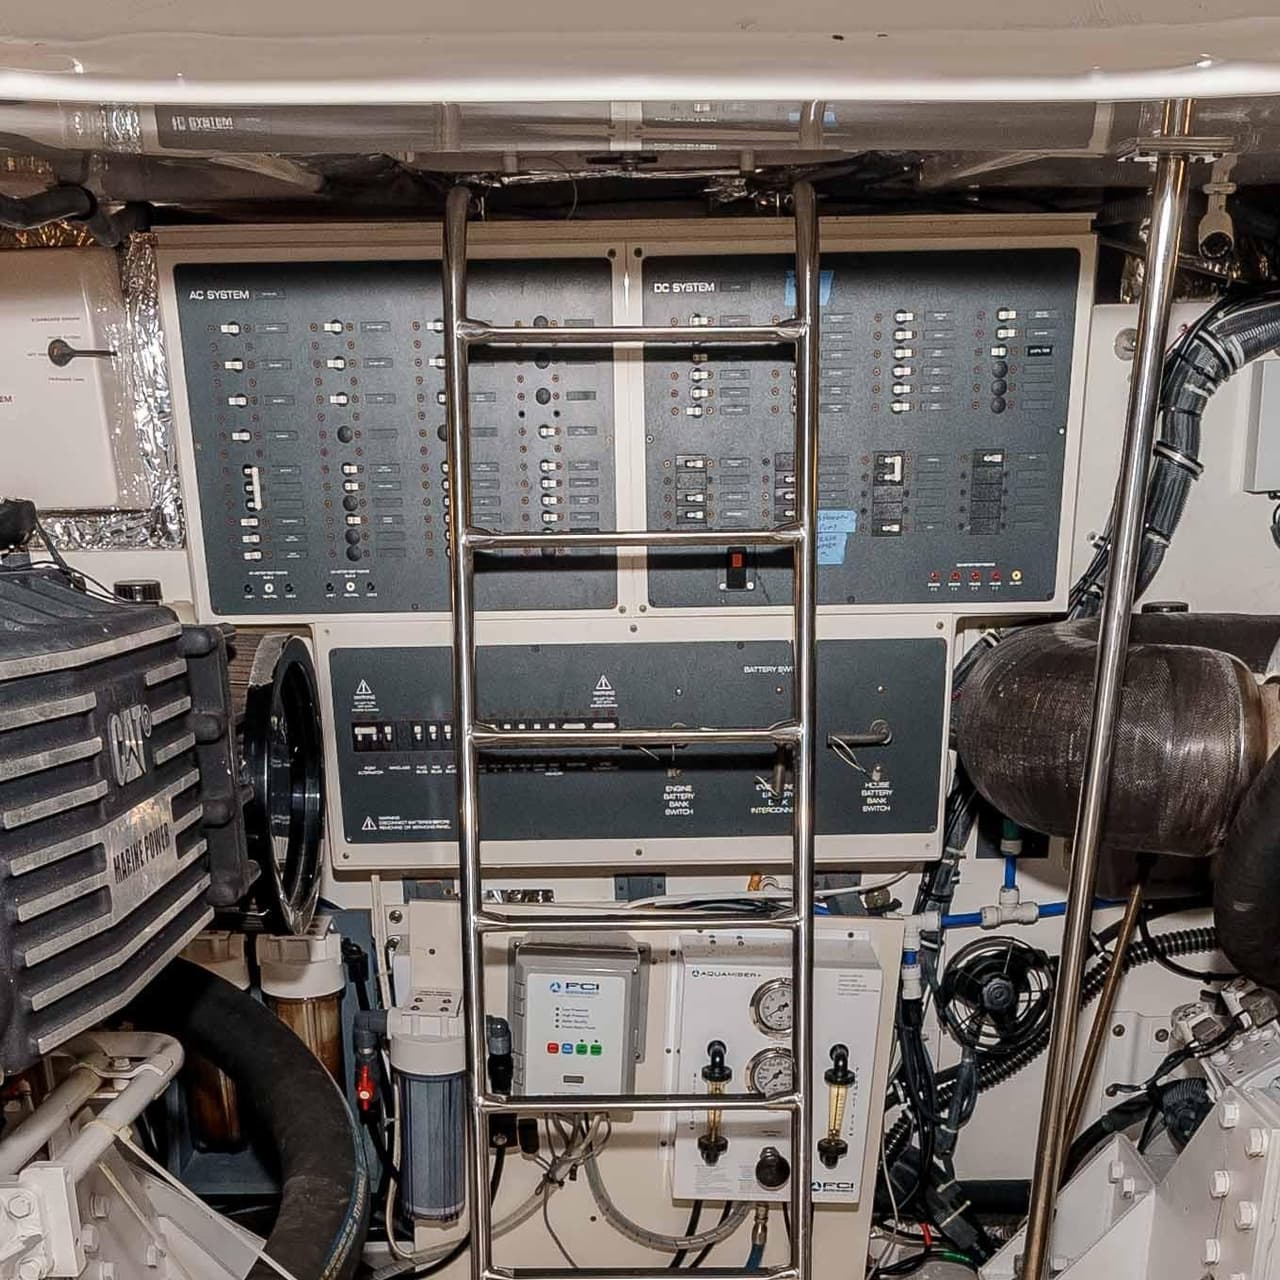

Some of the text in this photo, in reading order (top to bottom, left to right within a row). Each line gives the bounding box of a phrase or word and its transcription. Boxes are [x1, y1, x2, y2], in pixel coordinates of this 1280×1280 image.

[654, 282, 715, 293] DC SYSTEM
[189, 290, 250, 300] AC SYSTEM
[744, 666, 776, 674] BATTERY
[109, 704, 147, 786] CAT
[665, 785, 693, 793] ENGINE
[865, 781, 890, 789] HOUSE
[861, 789, 894, 797] BATTERY
[665, 808, 694, 816] SWITCH
[862, 805, 891, 813] SWITCH
[113, 822, 170, 884] MARINE POWER
[566, 982, 600, 990] FCI
[823, 1182, 855, 1190] FCI
